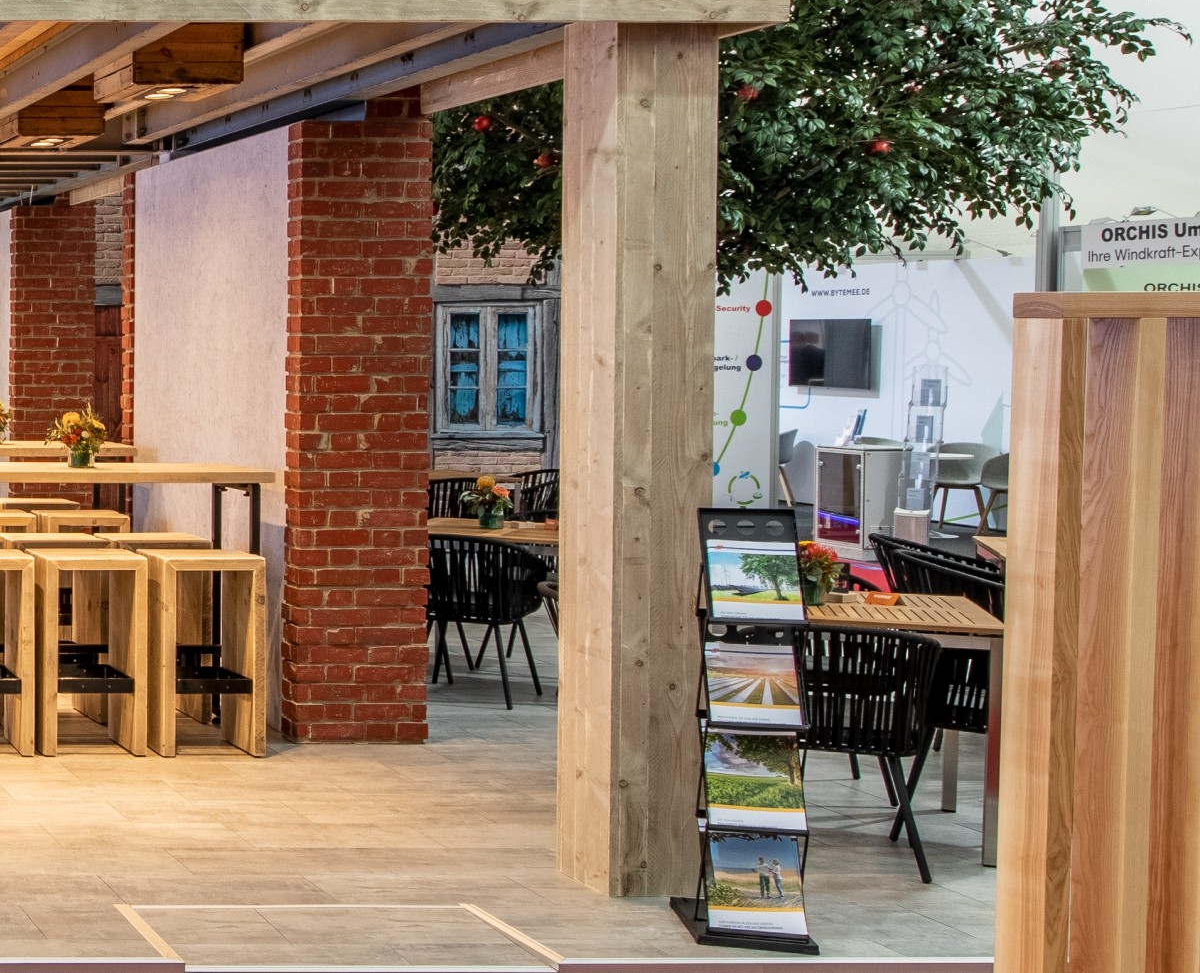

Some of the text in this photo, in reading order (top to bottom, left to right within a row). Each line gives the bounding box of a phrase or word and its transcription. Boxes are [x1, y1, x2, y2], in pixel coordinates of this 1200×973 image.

[1101, 224, 1169, 242] ORCHIS
[1088, 250, 1111, 262] Ihre
[811, 288, 870, 297] WWW.BYTEMEE.DE
